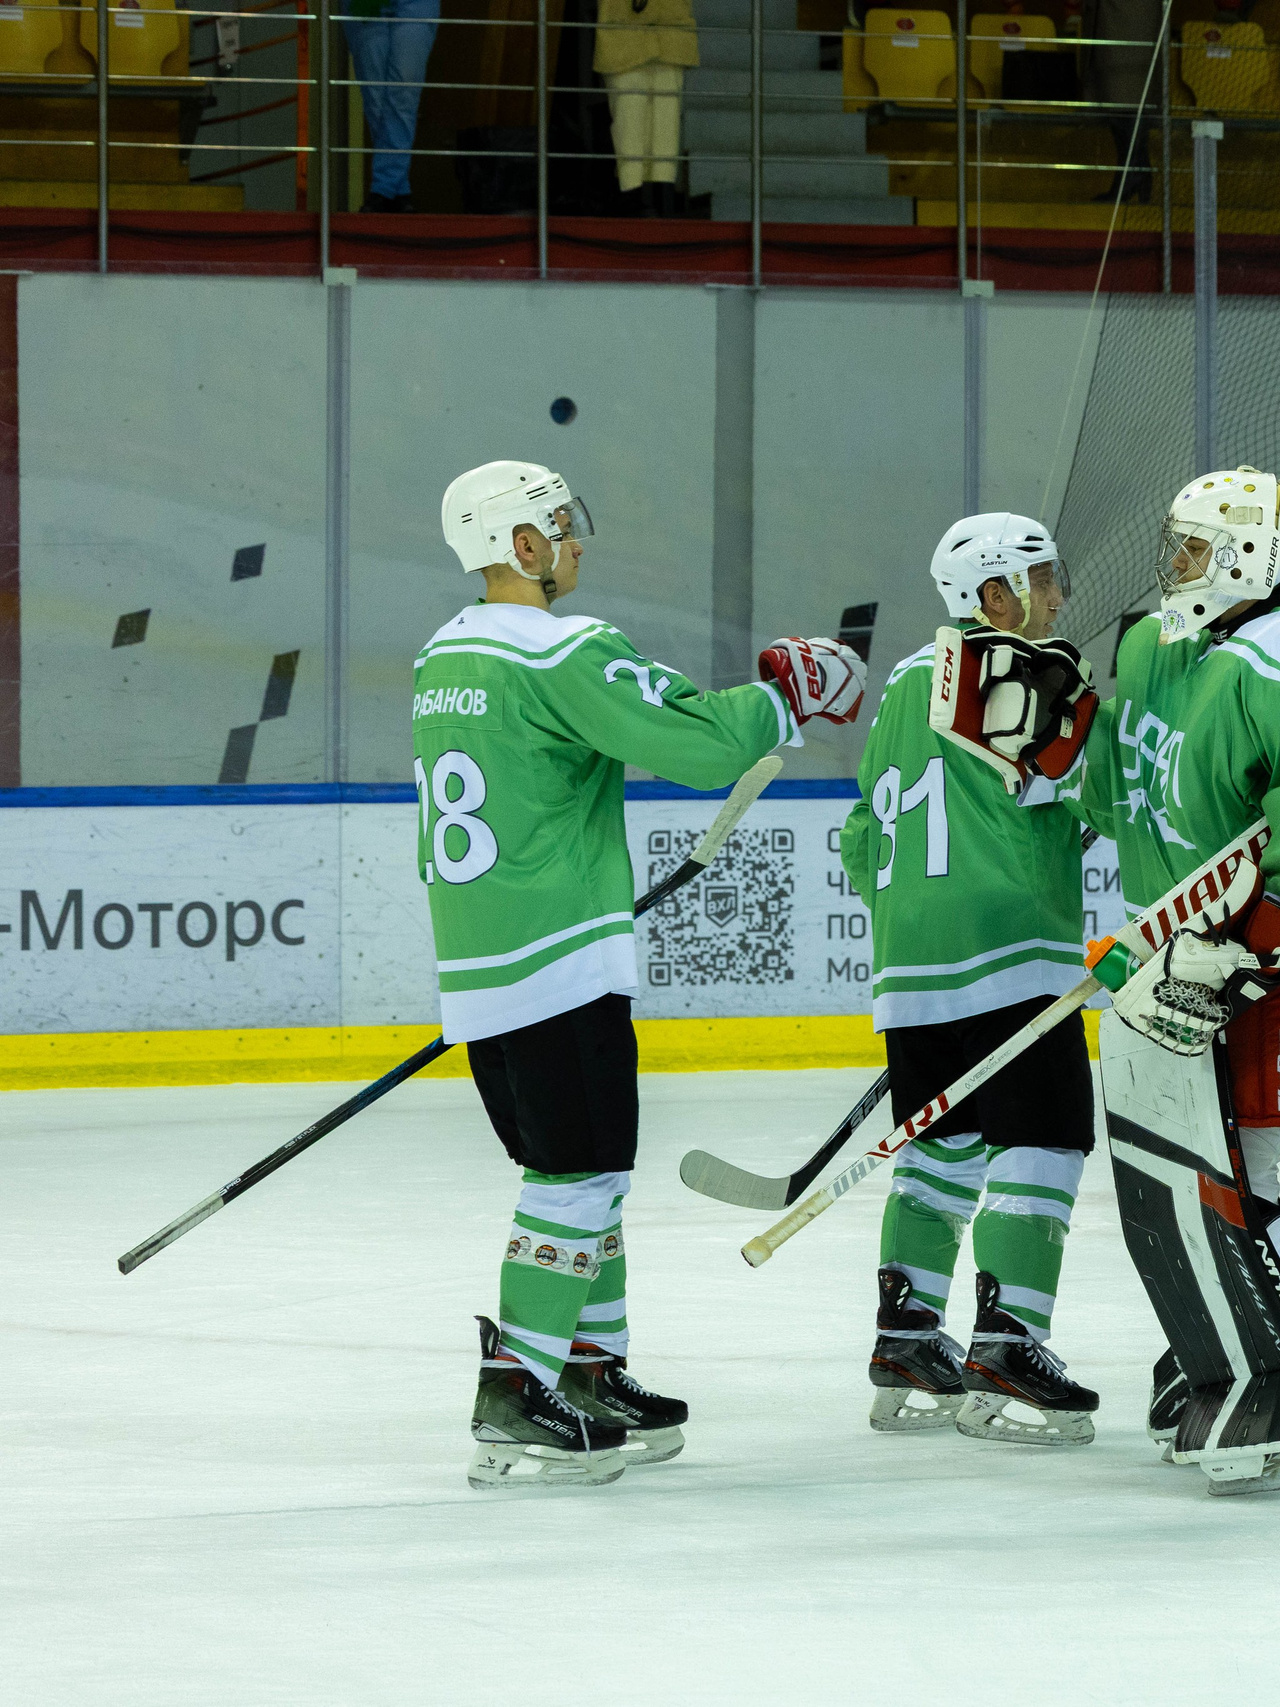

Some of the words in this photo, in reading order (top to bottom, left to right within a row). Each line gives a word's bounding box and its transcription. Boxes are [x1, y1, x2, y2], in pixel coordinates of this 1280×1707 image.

[1264, 536, 1280, 588] BAUER
[941, 646, 955, 703] CCM
[708, 897, 736, 916] ВХЛ
[531, 1413, 577, 1440] BAUER
